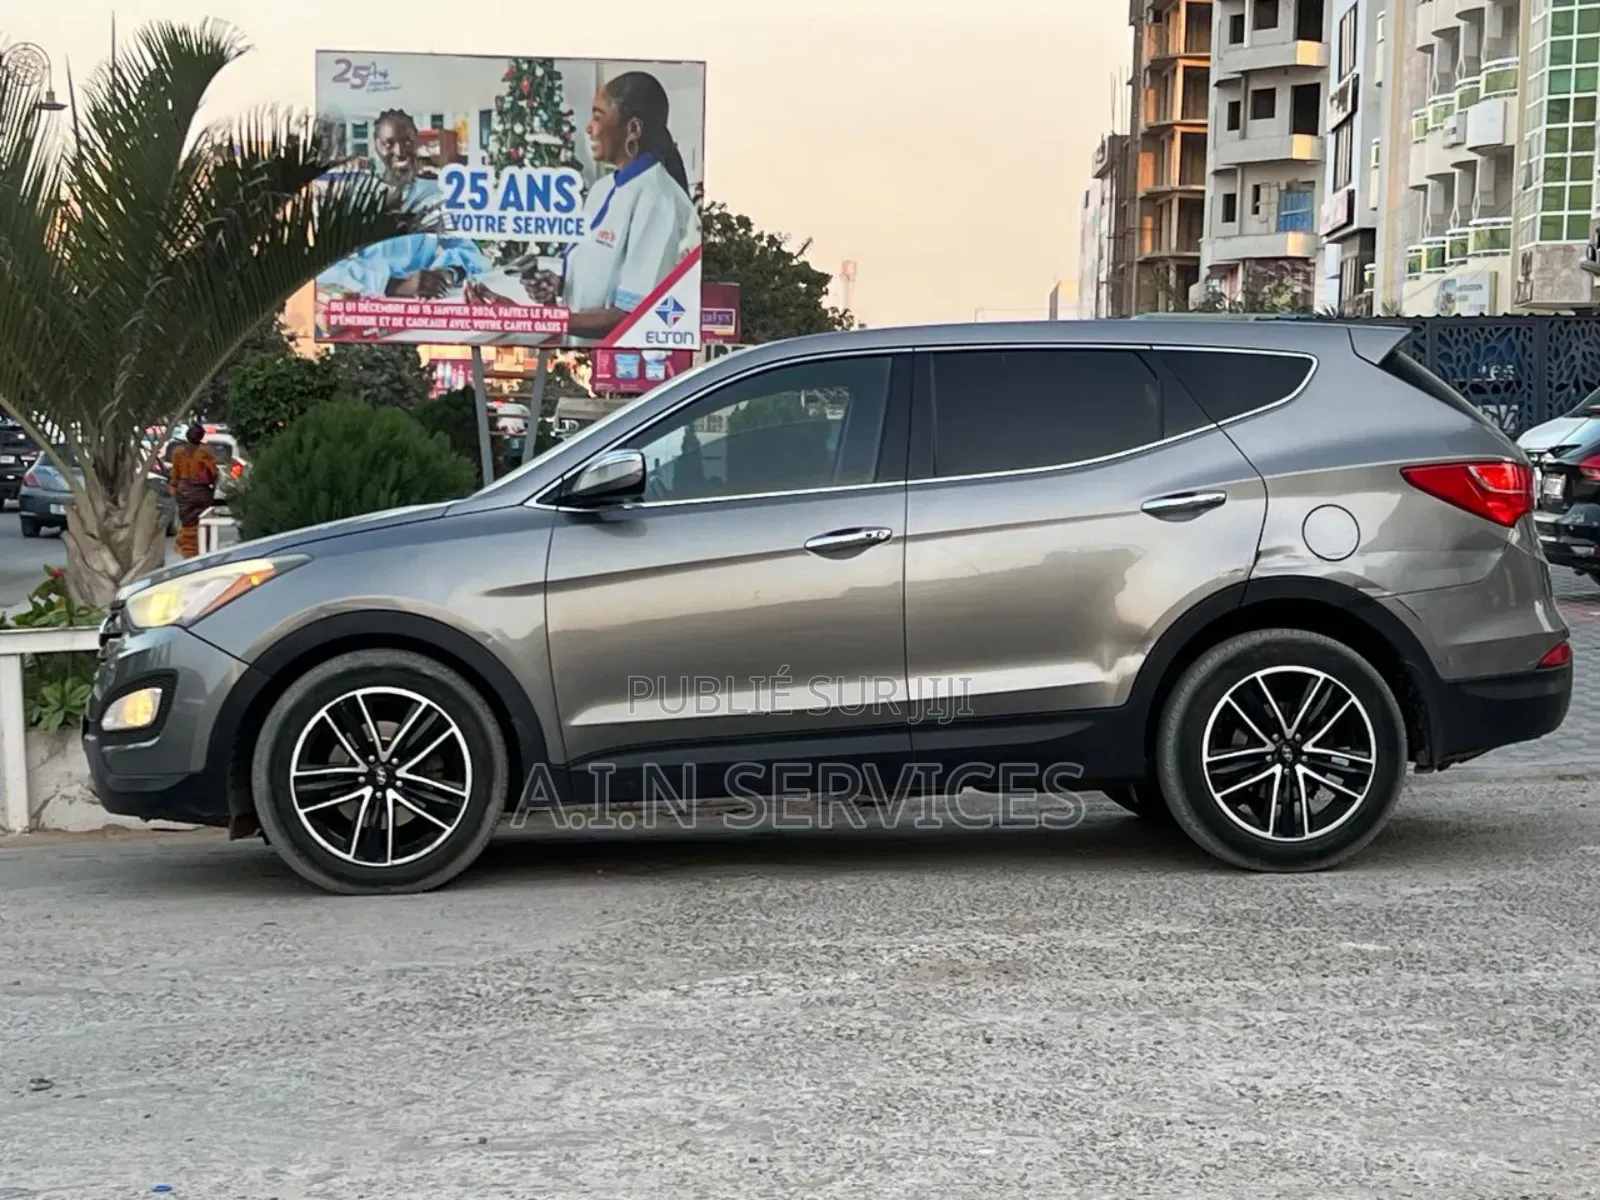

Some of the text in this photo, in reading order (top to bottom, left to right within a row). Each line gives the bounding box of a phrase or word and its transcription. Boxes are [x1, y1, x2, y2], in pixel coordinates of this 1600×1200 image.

[332, 58, 368, 89] 25
[445, 171, 577, 213] 25 ANS
[451, 213, 584, 236] VOTRE SERVICE
[407, 303, 420, 314] AU
[433, 304, 470, 316] JANVIER
[498, 307, 529, 318] FAITES
[530, 308, 541, 319] LE
[542, 308, 569, 319] PLEIN
[379, 315, 391, 326] ET
[391, 316, 404, 327] DE
[405, 316, 448, 328] CADEAUX
[449, 319, 472, 329] AVEC
[473, 320, 503, 331] VOTRE
[503, 320, 533, 332] CARTE
[645, 331, 694, 345] ELTON
